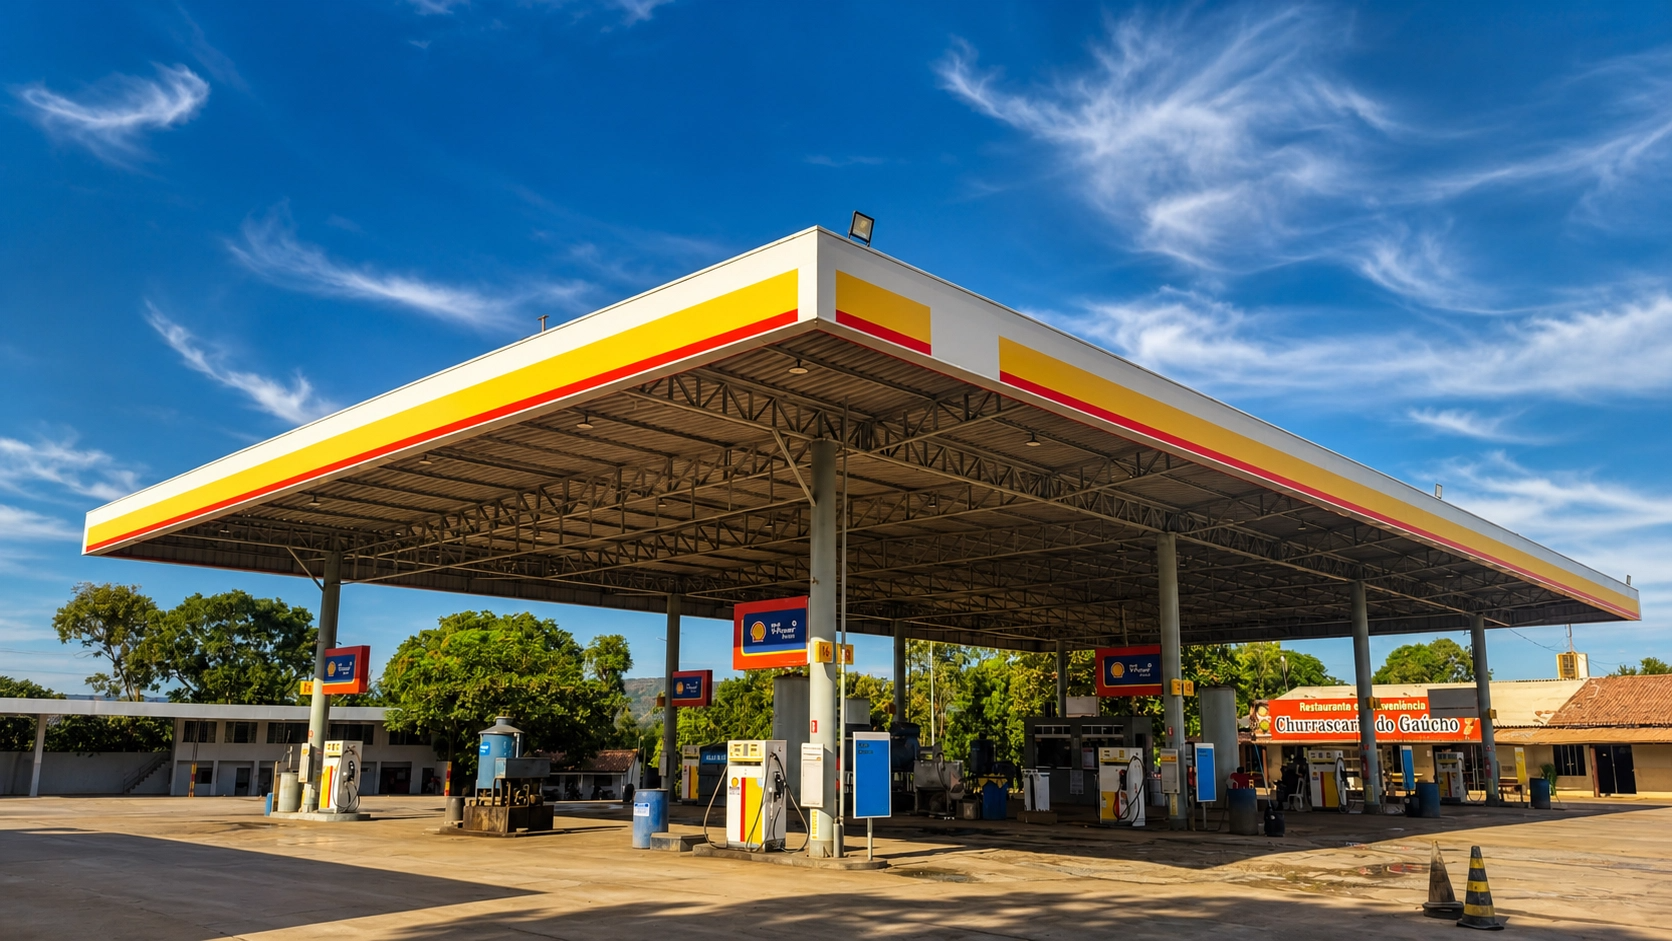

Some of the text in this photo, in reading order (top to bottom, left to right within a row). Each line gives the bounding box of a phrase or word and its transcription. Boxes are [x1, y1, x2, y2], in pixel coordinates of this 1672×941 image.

[1275, 713, 1460, 734] Churrascari do Gaúcho
